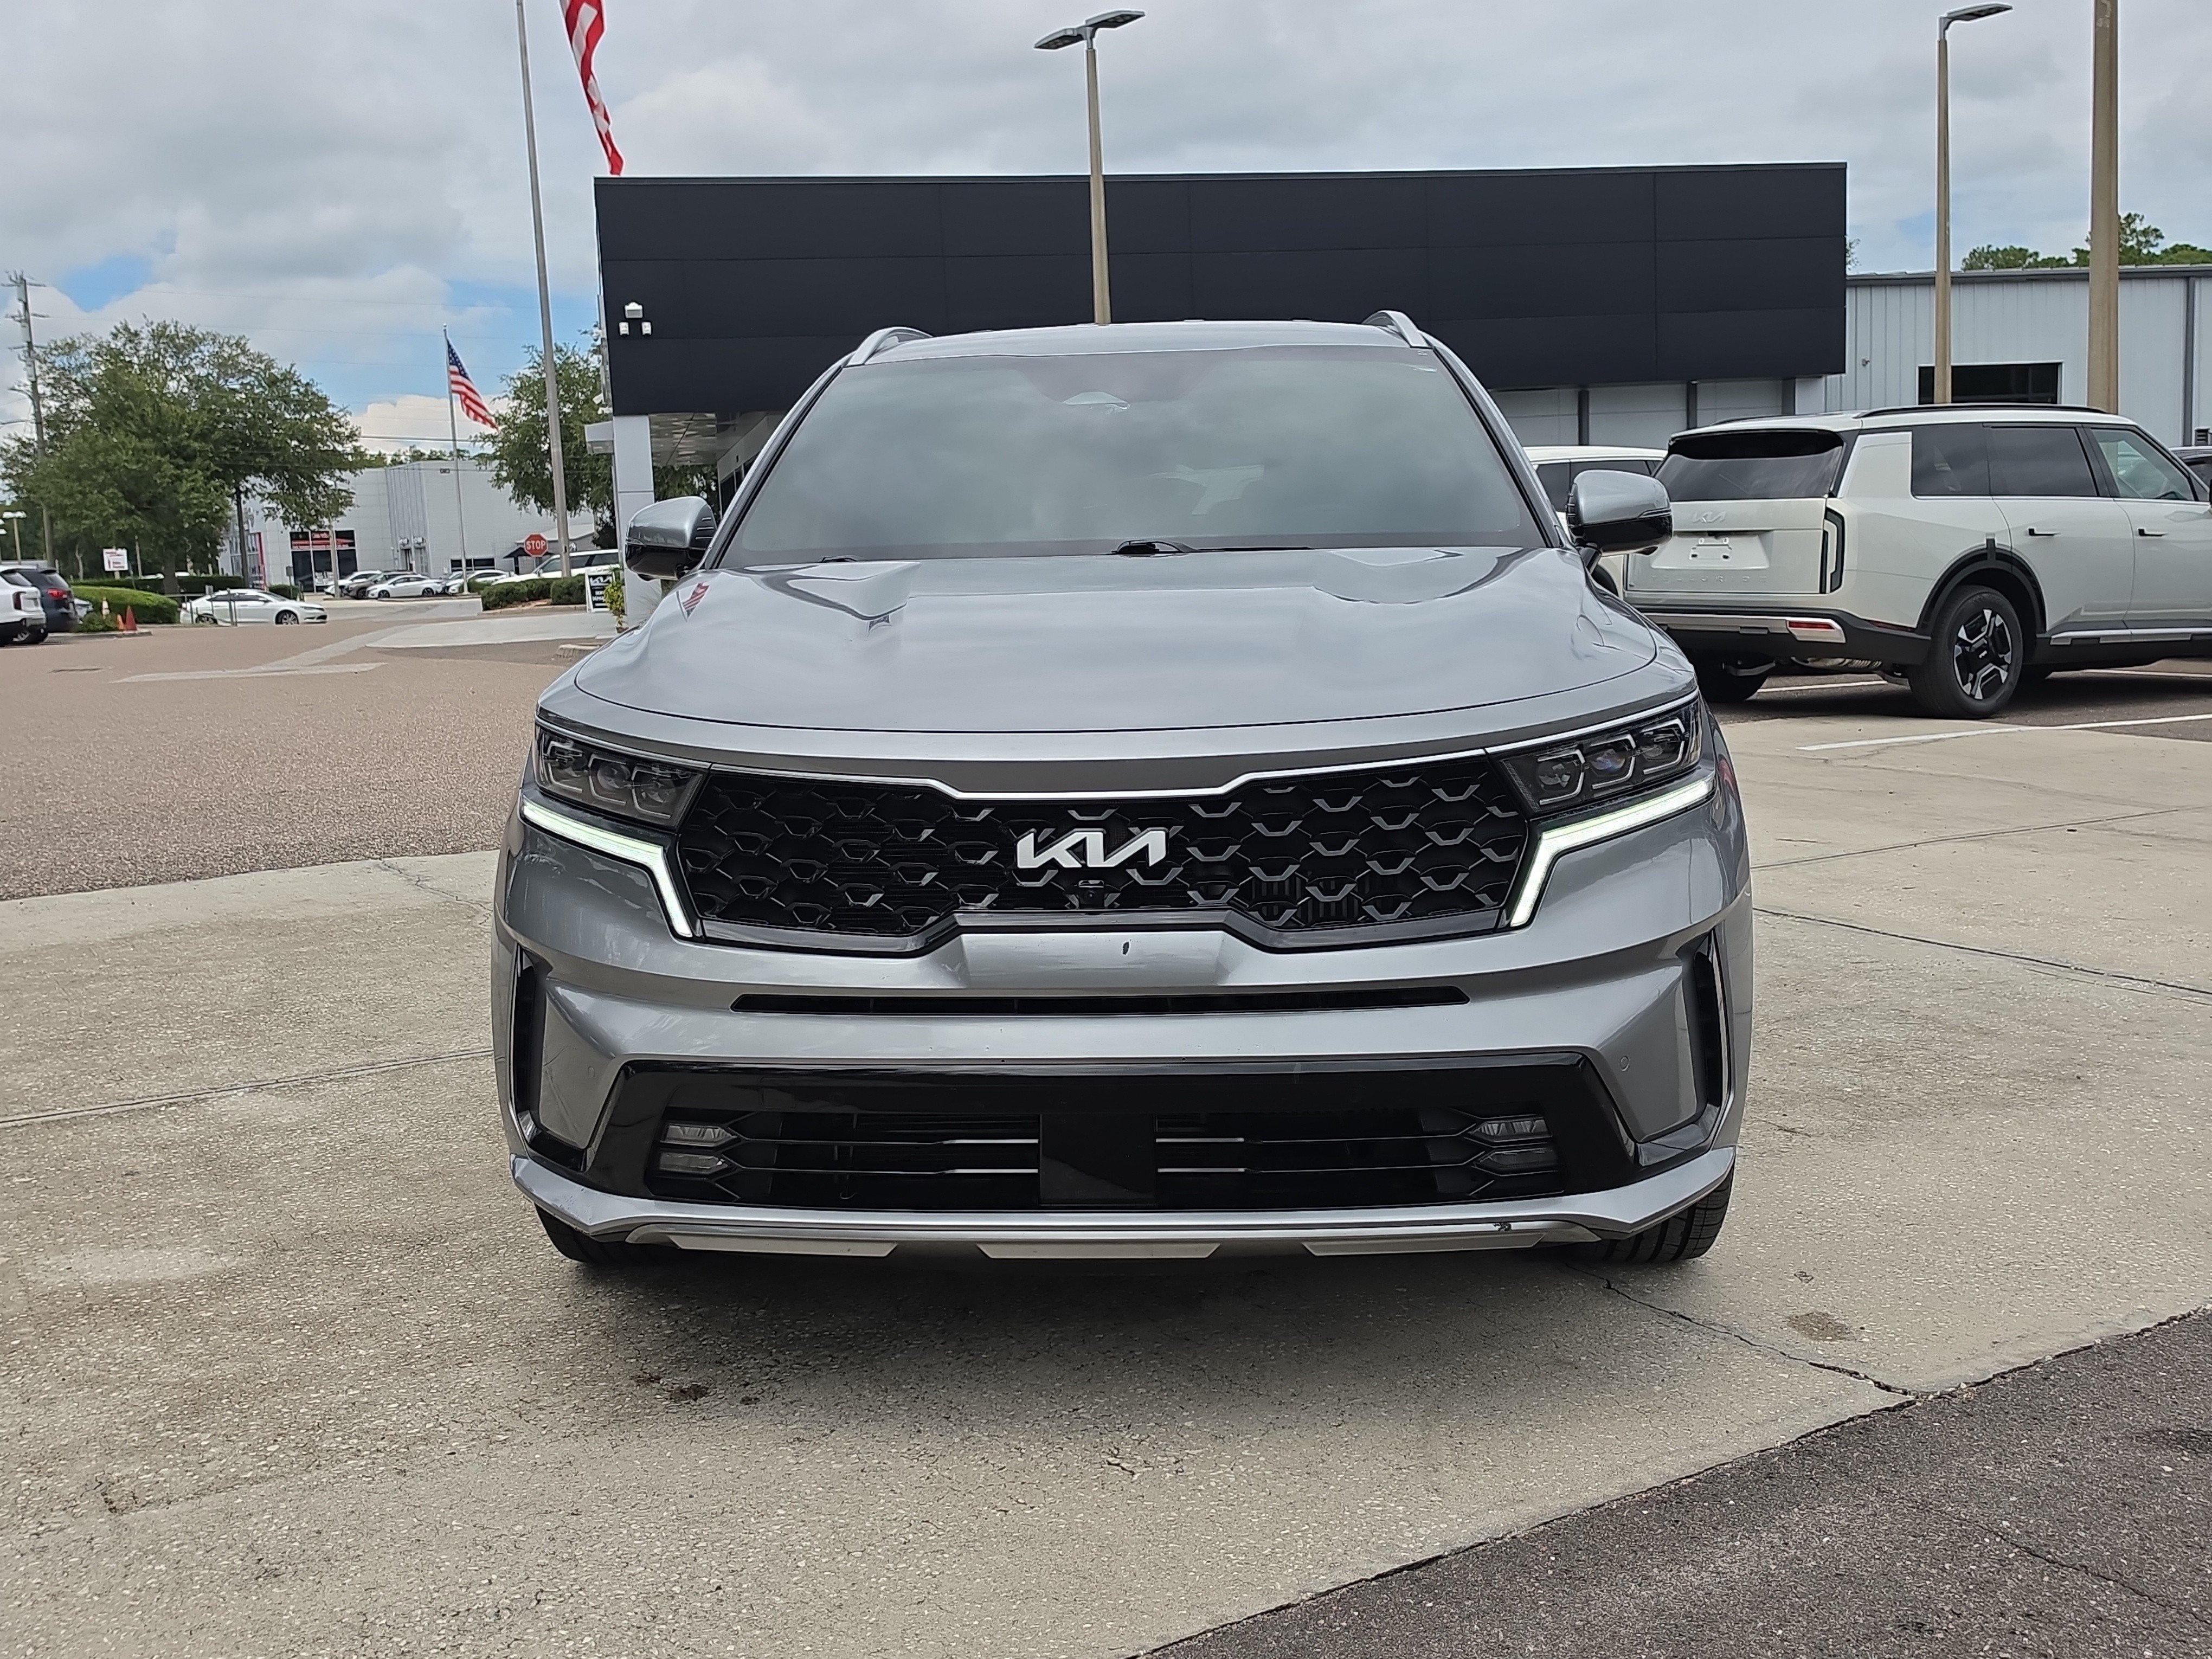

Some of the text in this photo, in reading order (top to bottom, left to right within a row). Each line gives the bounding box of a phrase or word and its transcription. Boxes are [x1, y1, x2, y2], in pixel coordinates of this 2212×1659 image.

[1692, 512, 1726, 523] KIA
[526, 539, 546, 550] STOP
[589, 576, 612, 584] KIA
[1017, 830, 1166, 869] KIA
